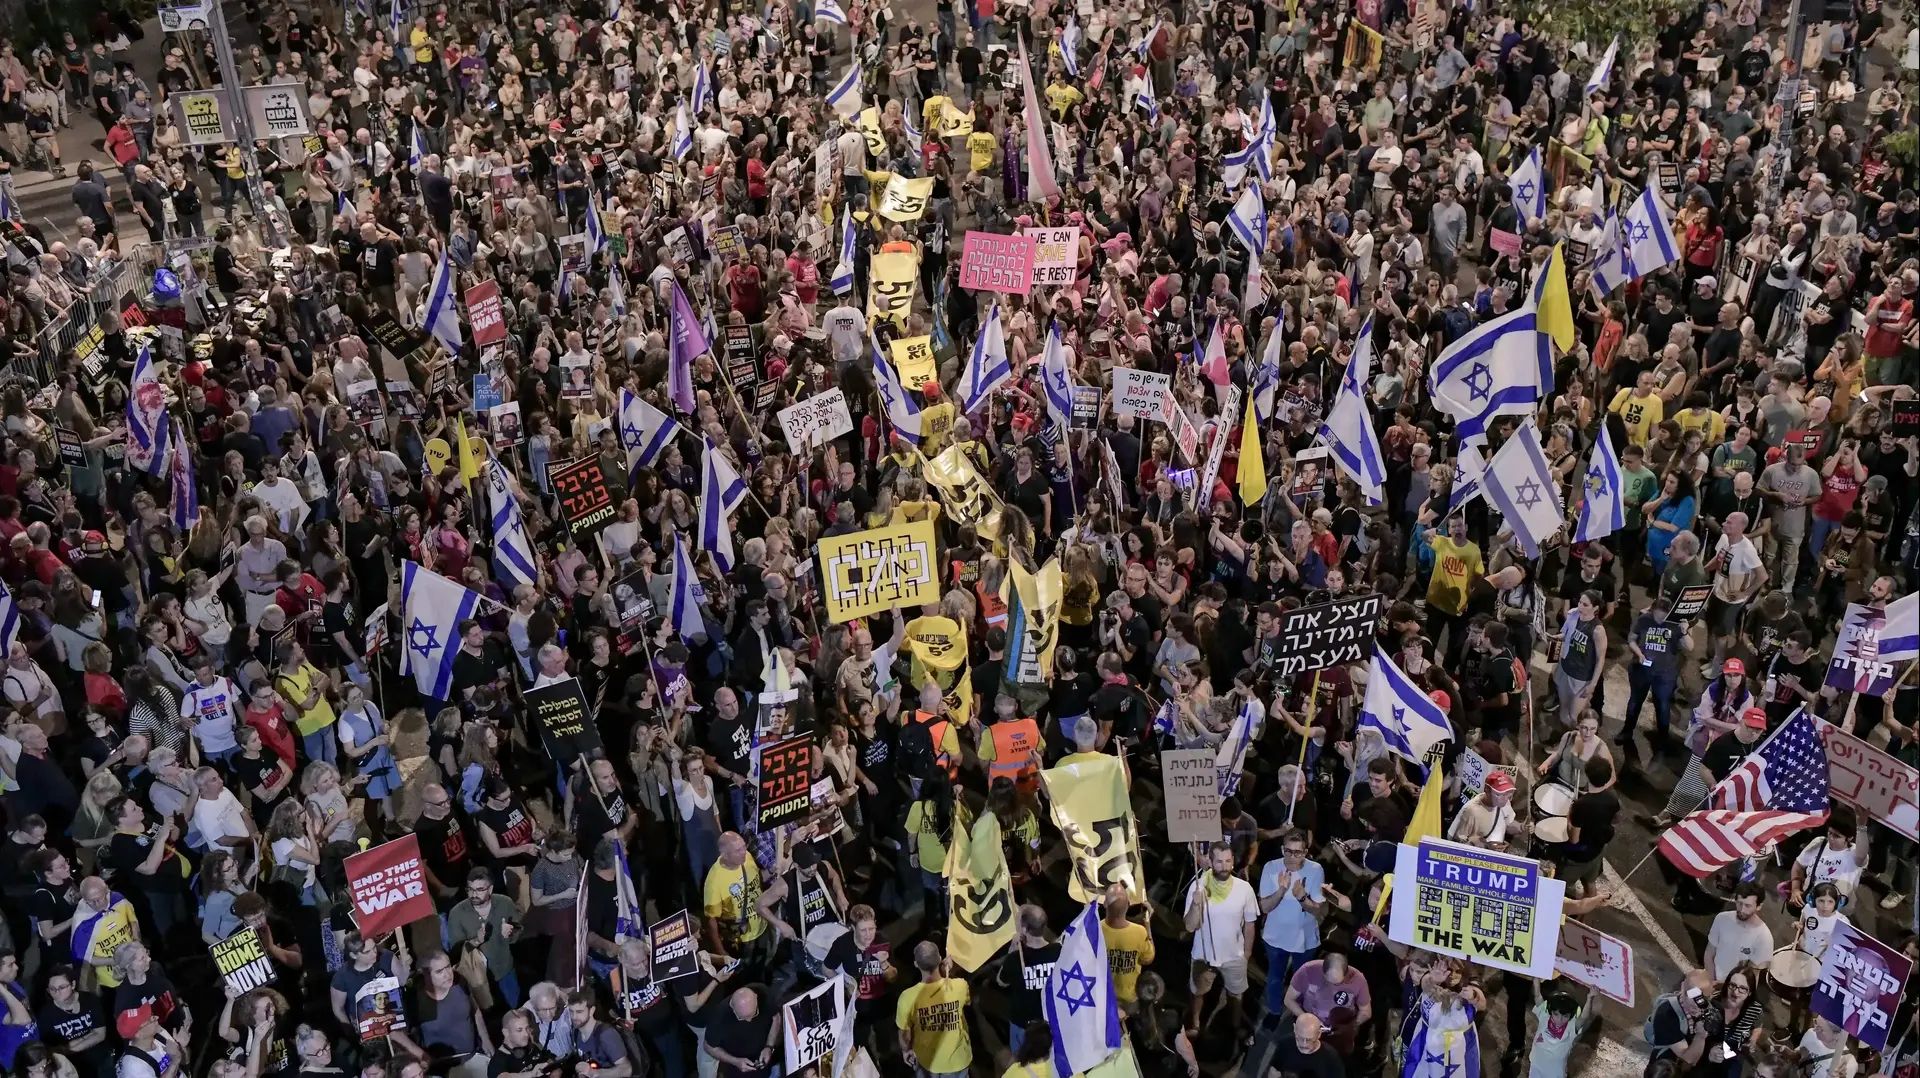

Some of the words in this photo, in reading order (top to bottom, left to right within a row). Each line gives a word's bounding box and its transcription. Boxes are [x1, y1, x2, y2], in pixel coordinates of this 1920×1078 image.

[190, 113, 219, 128] אשם
[267, 108, 296, 120] אשם
[191, 127, 222, 136] במחדל
[269, 121, 299, 131] במחדל
[971, 237, 1007, 253] נוותר
[1053, 231, 1070, 243] CAN
[1009, 241, 1028, 254] לא
[1034, 244, 1067, 262] SAVE
[968, 250, 1026, 269] לממשלת
[966, 264, 1024, 288] ההפקר!
[1033, 267, 1045, 282] HE
[1047, 267, 1075, 282] REST
[483, 295, 497, 307] THIS
[472, 313, 502, 332] WAR
[1129, 373, 1140, 382] פה
[1143, 375, 1154, 386] ישן
[1158, 377, 1167, 385] מי
[1127, 385, 1150, 396] מצפון
[1629, 403, 1644, 415] צו
[1625, 413, 1641, 425] 59
[556, 465, 603, 497] ביבי
[563, 485, 609, 513] בוגד
[1328, 597, 1379, 625] תציל
[1284, 609, 1321, 633] את
[1282, 622, 1375, 652] המדינה
[1845, 623, 1878, 643] אר
[928, 644, 953, 656] 59
[1274, 643, 1362, 678] מעצמך
[1832, 656, 1894, 680] בגידה
[537, 696, 579, 715] ממשלת
[543, 708, 583, 727] הסטרא
[552, 723, 584, 738] אחרא
[733, 742, 751, 760] Life
[1010, 746, 1030, 754] מתנדב
[1011, 740, 1027, 748] סדרן
[762, 747, 810, 774] ביבי
[1170, 758, 1214, 770] מורשת
[1465, 753, 1482, 772] 582
[762, 770, 809, 799] בוגד
[1170, 776, 1213, 788] נתניהו:
[760, 795, 809, 823] בחטופים
[1192, 795, 1217, 805] בתי
[1178, 808, 1217, 820] קברות
[1066, 816, 1137, 896] 59
[1436, 852, 1462, 863] TRUMP
[1464, 858, 1495, 869] PLEASE
[352, 871, 383, 890] END
[384, 858, 419, 877] THIS
[1425, 859, 1529, 892] TRUMP
[357, 881, 425, 916] WAR
[1417, 875, 1439, 885] MAKE
[1441, 880, 1475, 893] FAMILIES
[1478, 887, 1506, 899] WHOLE
[1508, 894, 1534, 904] AGAIN
[805, 898, 825, 910] עדיי
[1418, 885, 1529, 948] STOP
[212, 943, 228, 957] ALL
[232, 929, 256, 947] THEM
[656, 937, 688, 956] מסרבים
[1418, 925, 1462, 950] THE
[1471, 937, 1525, 964] WAR
[215, 941, 265, 975] HOME
[655, 948, 688, 964] למלחמה
[224, 956, 276, 994] NOW!
[1833, 944, 1900, 995] קטאר
[918, 1007, 930, 1016] את
[931, 1000, 960, 1012] משיבים
[1819, 977, 1888, 1030] בגידה
[806, 1021, 832, 1046] דגל
